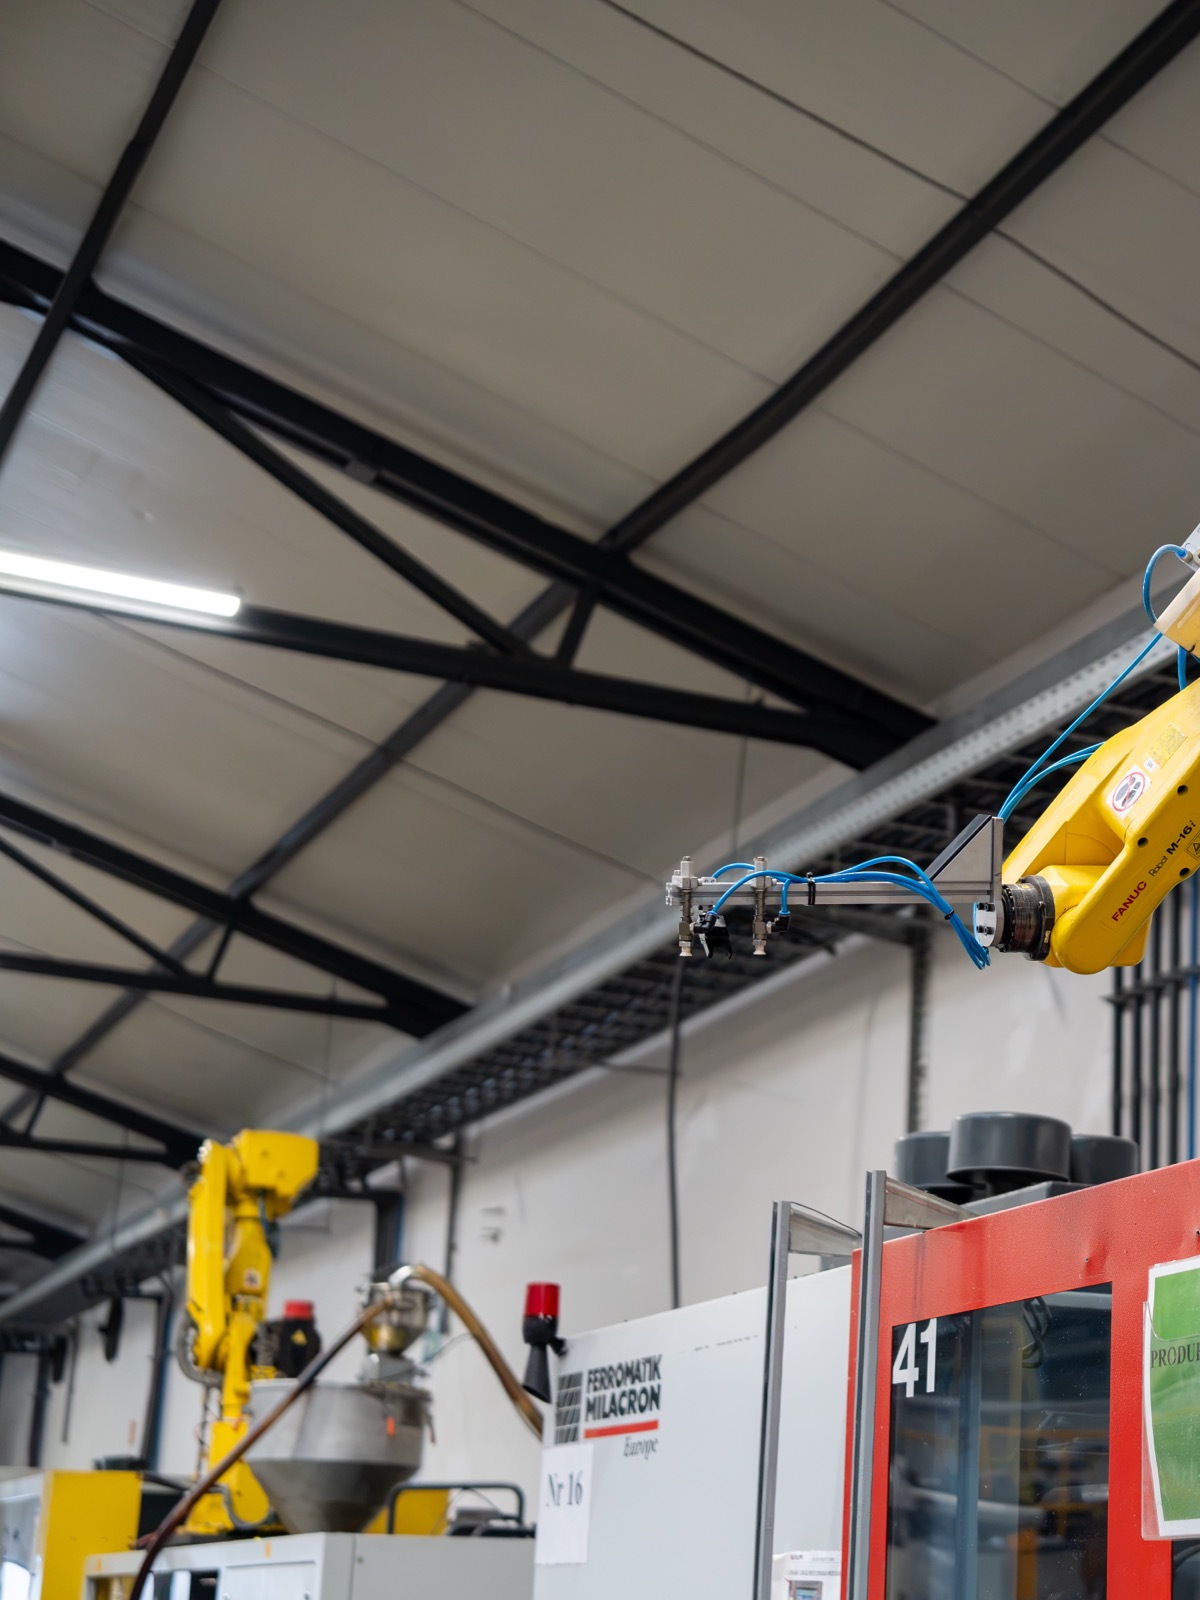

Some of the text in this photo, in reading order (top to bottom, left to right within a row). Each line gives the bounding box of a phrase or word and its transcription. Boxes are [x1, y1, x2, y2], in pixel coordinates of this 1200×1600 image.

[1111, 819, 1197, 922] FANUC Robot M-16i
[586, 1354, 662, 1394] FERROMATIK
[892, 1317, 937, 1398] 41
[585, 1383, 661, 1421] MILACRON
[623, 1436, 659, 1460] Europe
[546, 1469, 583, 1507] Nr 16
